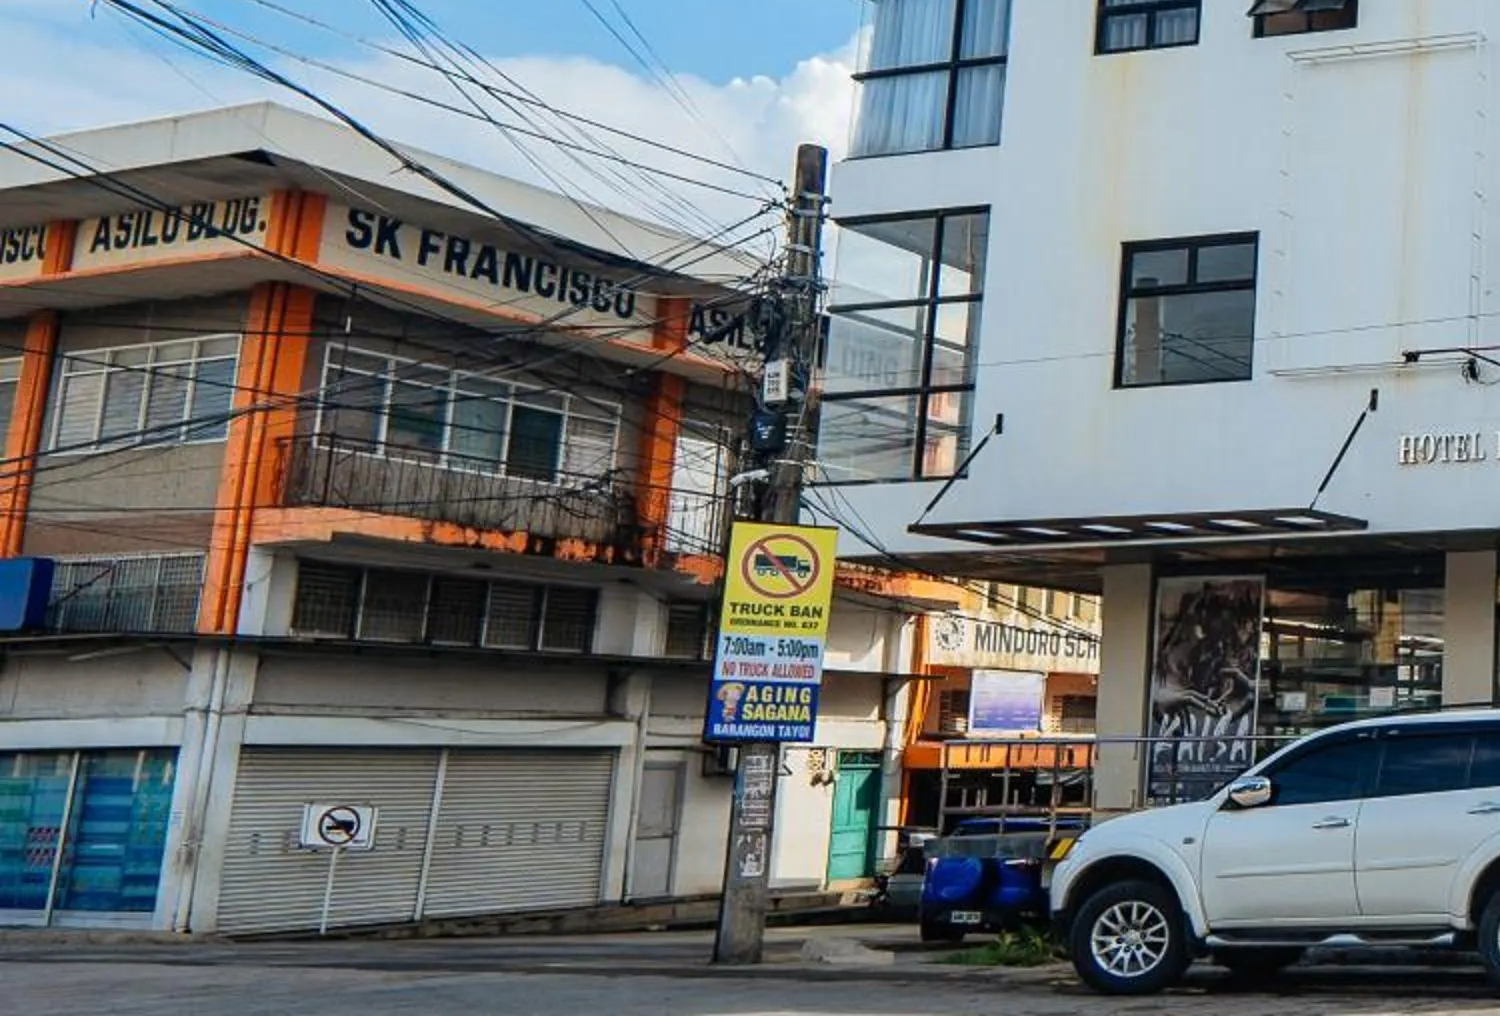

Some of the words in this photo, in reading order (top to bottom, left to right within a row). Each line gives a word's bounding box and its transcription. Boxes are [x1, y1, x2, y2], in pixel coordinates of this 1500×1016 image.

[346, 209, 402, 260] SK
[417, 229, 635, 319] FRANCISCO
[1399, 433, 1487, 464] HOTEL
[729, 601, 785, 617] TRUCK
[790, 605, 823, 618] BAN
[724, 636, 766, 657] 7:00am
[777, 639, 819, 661] 5:00pm
[974, 622, 1060, 658] MINDORO
[1064, 633, 1097, 660] SCH
[721, 661, 737, 677] NO
[739, 662, 769, 678] TRUCK
[772, 663, 815, 679] ALLOWED
[745, 686, 811, 704] AGING
[741, 704, 811, 722] SAGANA
